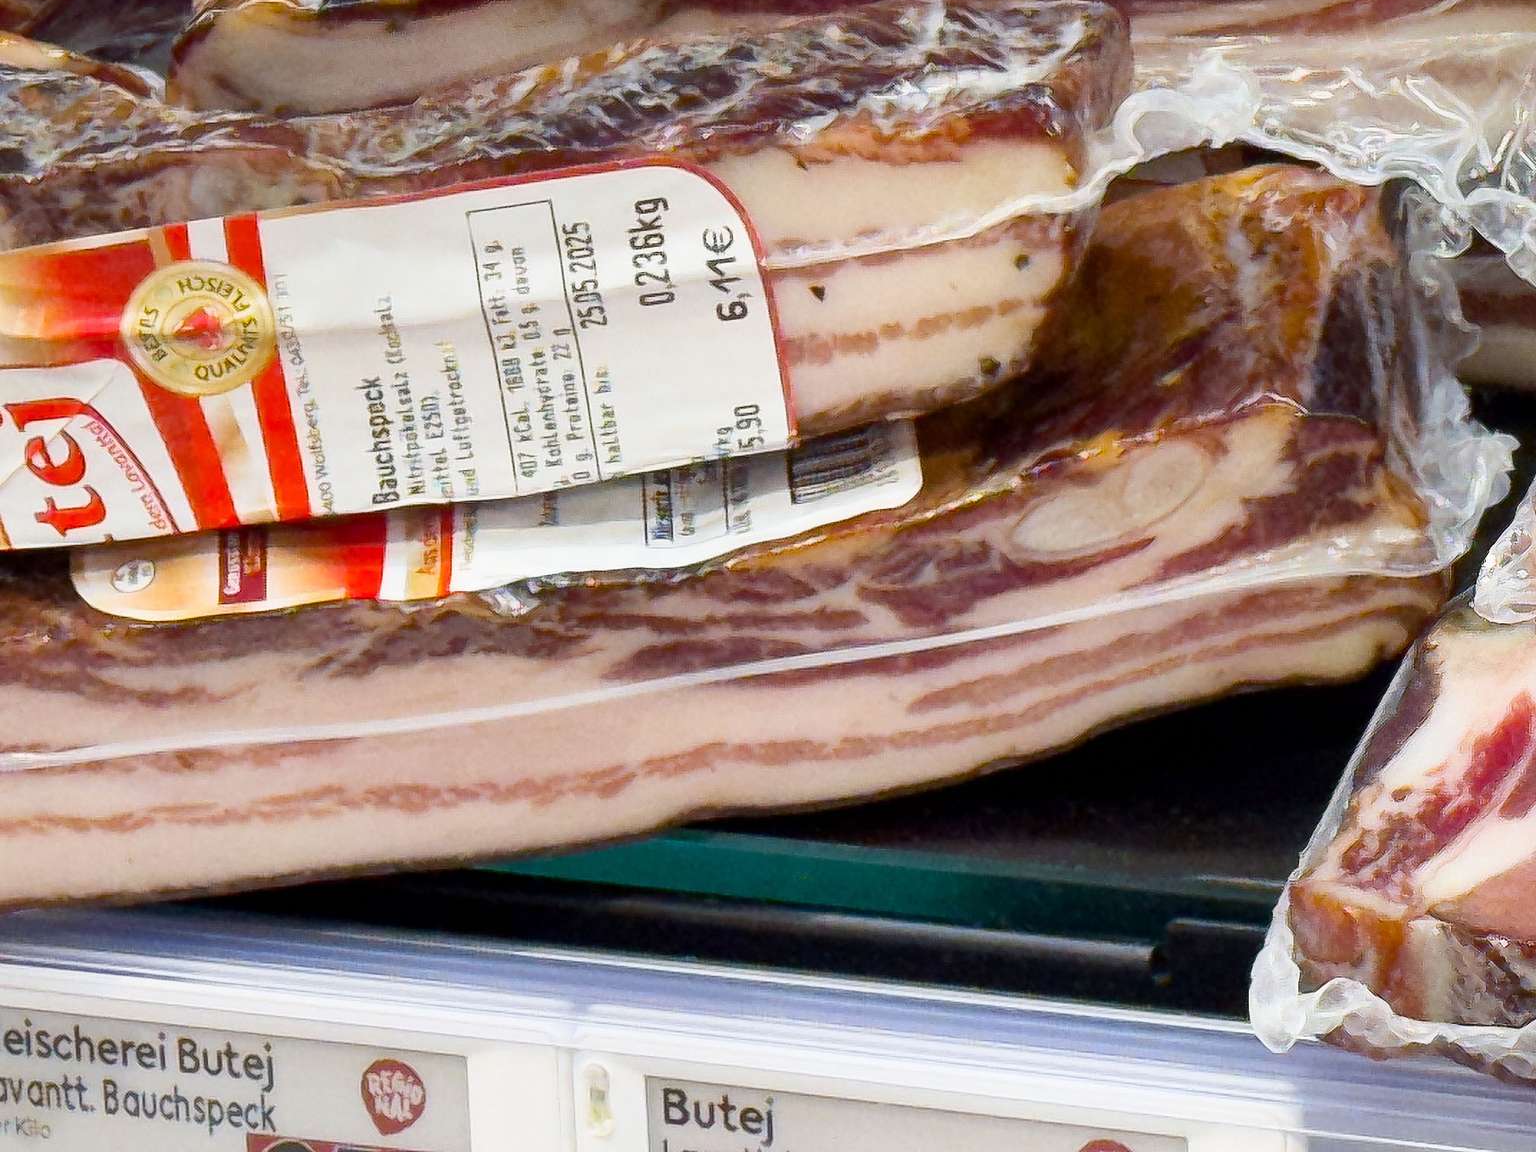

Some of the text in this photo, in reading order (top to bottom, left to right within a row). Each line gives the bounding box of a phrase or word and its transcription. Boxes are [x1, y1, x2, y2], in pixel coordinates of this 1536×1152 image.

[702, 225, 753, 323] 6,11€
[355, 375, 400, 506] Bauchspeck
[3, 1017, 274, 1094] eischerei Butej
[103, 1078, 277, 1135] Bauchspeck
[662, 1087, 775, 1145] Butej
